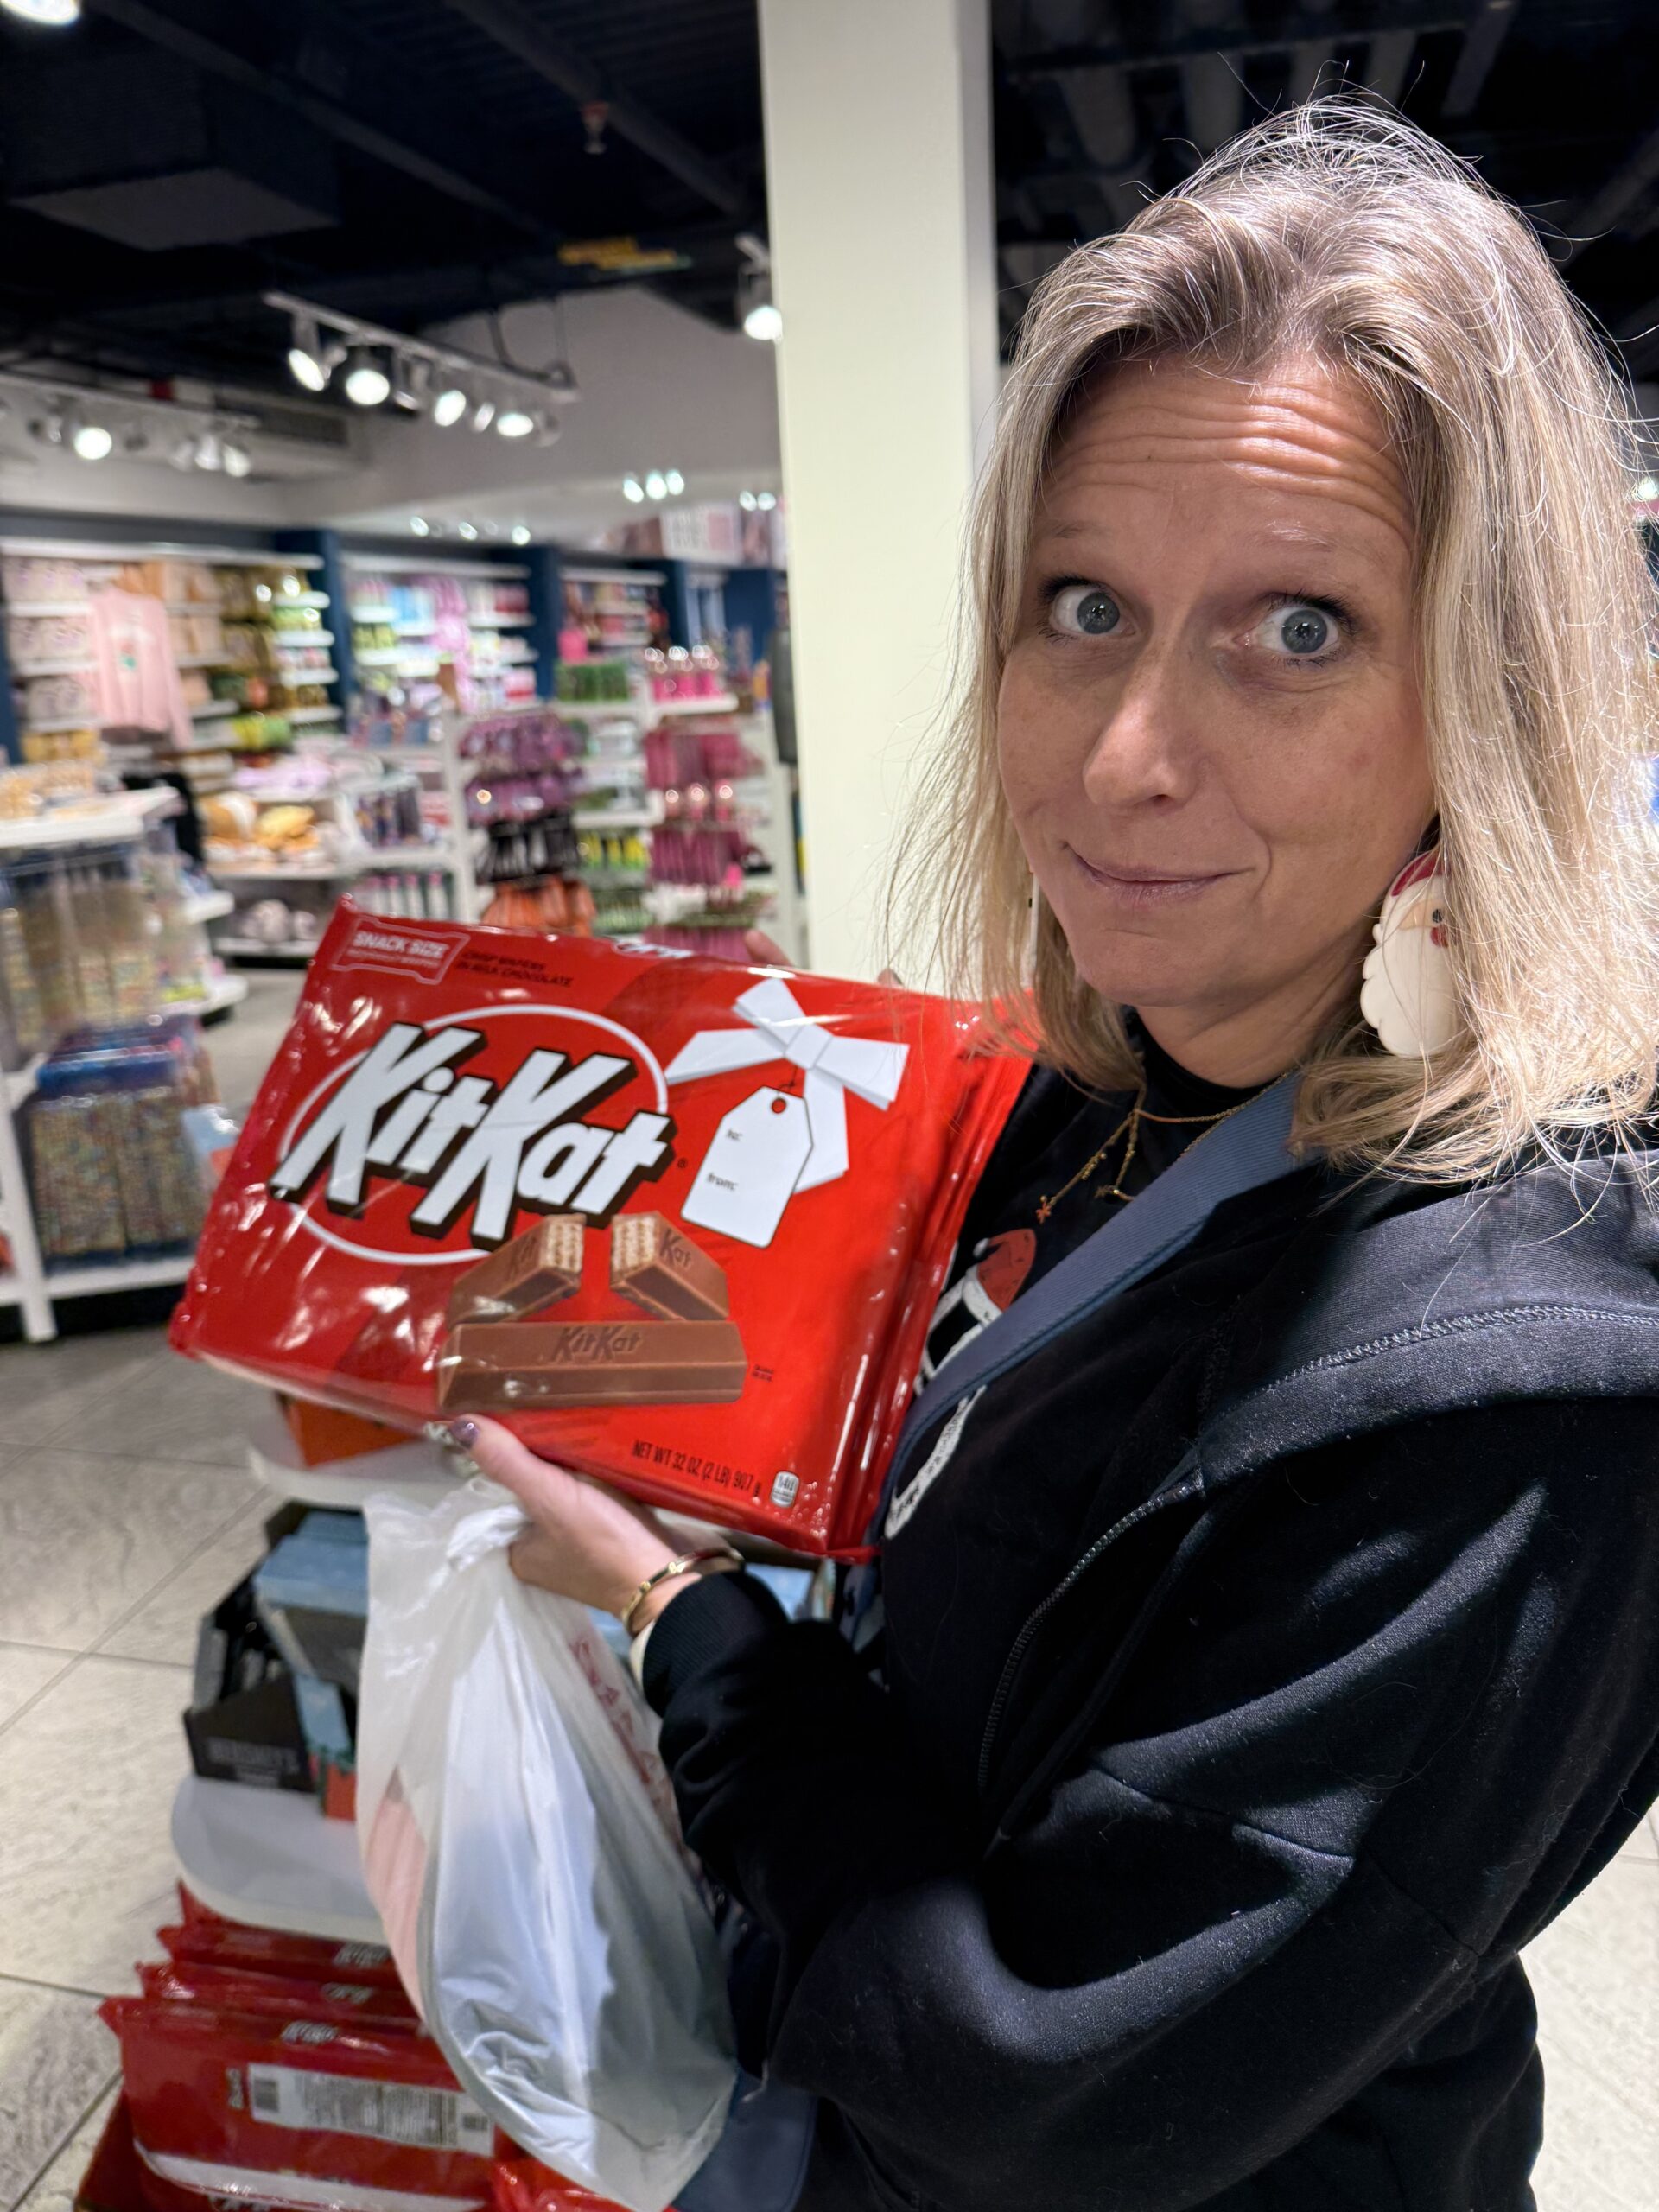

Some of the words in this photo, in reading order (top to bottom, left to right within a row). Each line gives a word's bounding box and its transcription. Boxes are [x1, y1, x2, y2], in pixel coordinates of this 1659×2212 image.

[352, 930, 407, 951] SNACK
[410, 938, 450, 959] SIZE
[633, 1440, 653, 1459] NET
[654, 1446, 672, 1466] WT
[673, 1452, 687, 1472] 32
[687, 1457, 703, 1478] OZ
